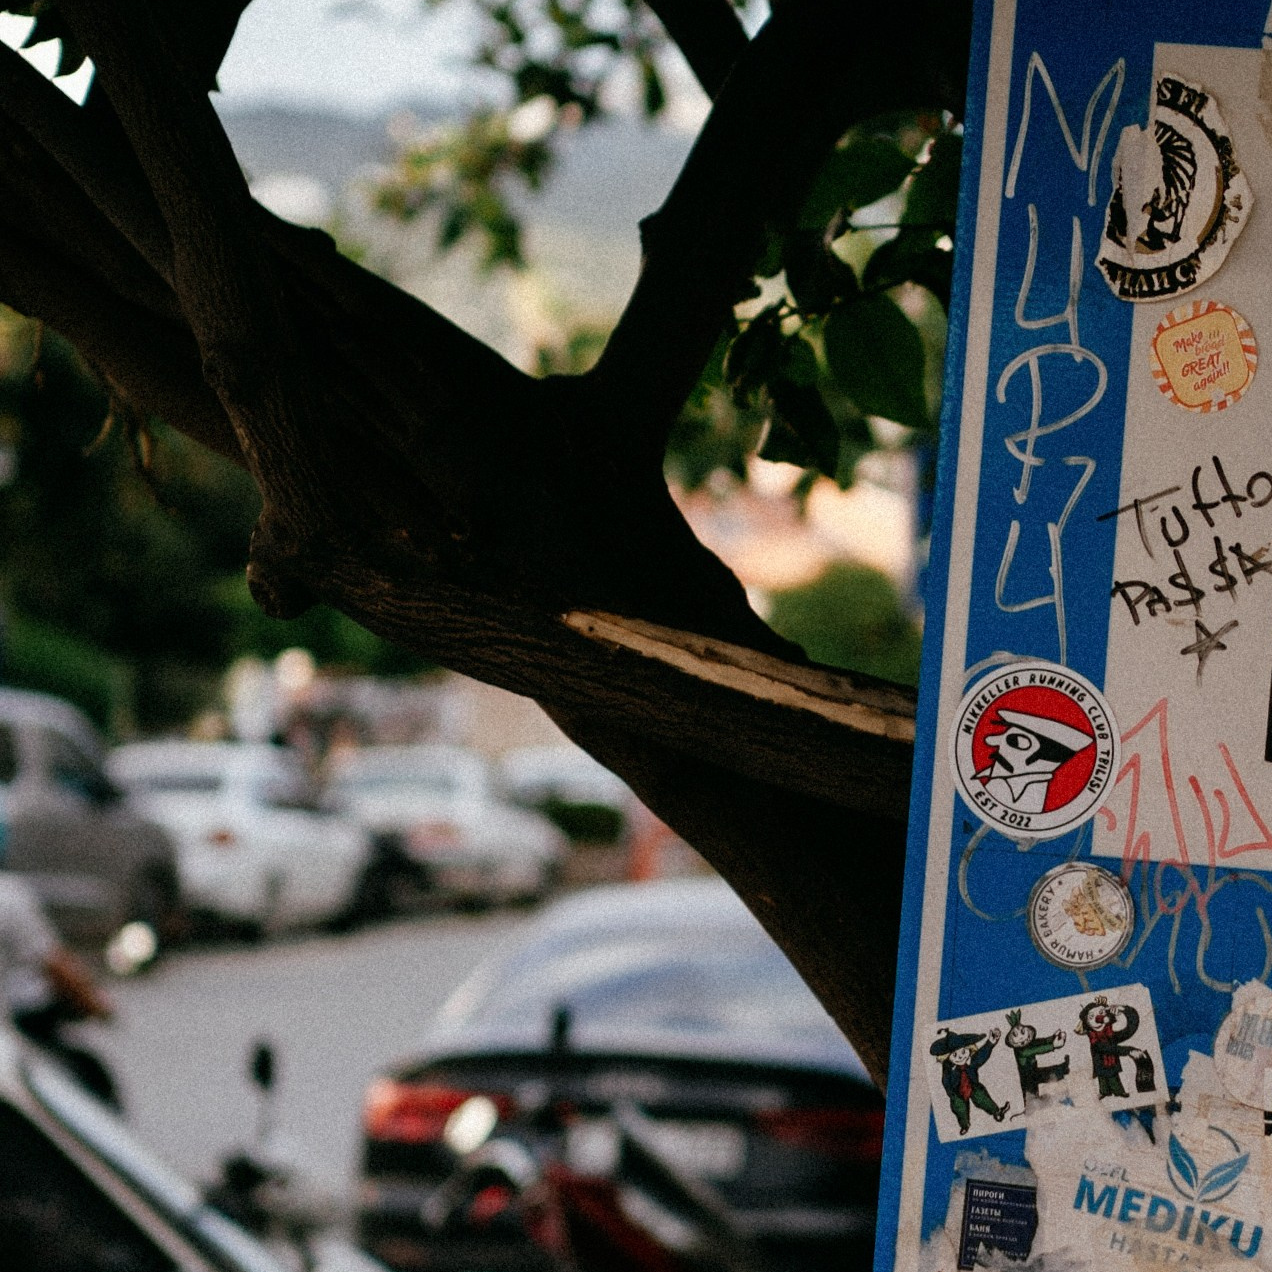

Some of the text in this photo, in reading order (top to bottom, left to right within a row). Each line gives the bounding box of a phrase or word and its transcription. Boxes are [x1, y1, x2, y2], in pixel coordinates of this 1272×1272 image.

[1173, 331, 1203, 353] Make
[1181, 351, 1222, 378] GREAT
[962, 675, 1020, 735] MIKKELLER
[1029, 673, 1087, 703] RUNNING
[1087, 706, 1109, 740] CLUB
[974, 790, 1032, 828] EST 2022
[1038, 886, 1093, 960] HAMUR BAKERY
